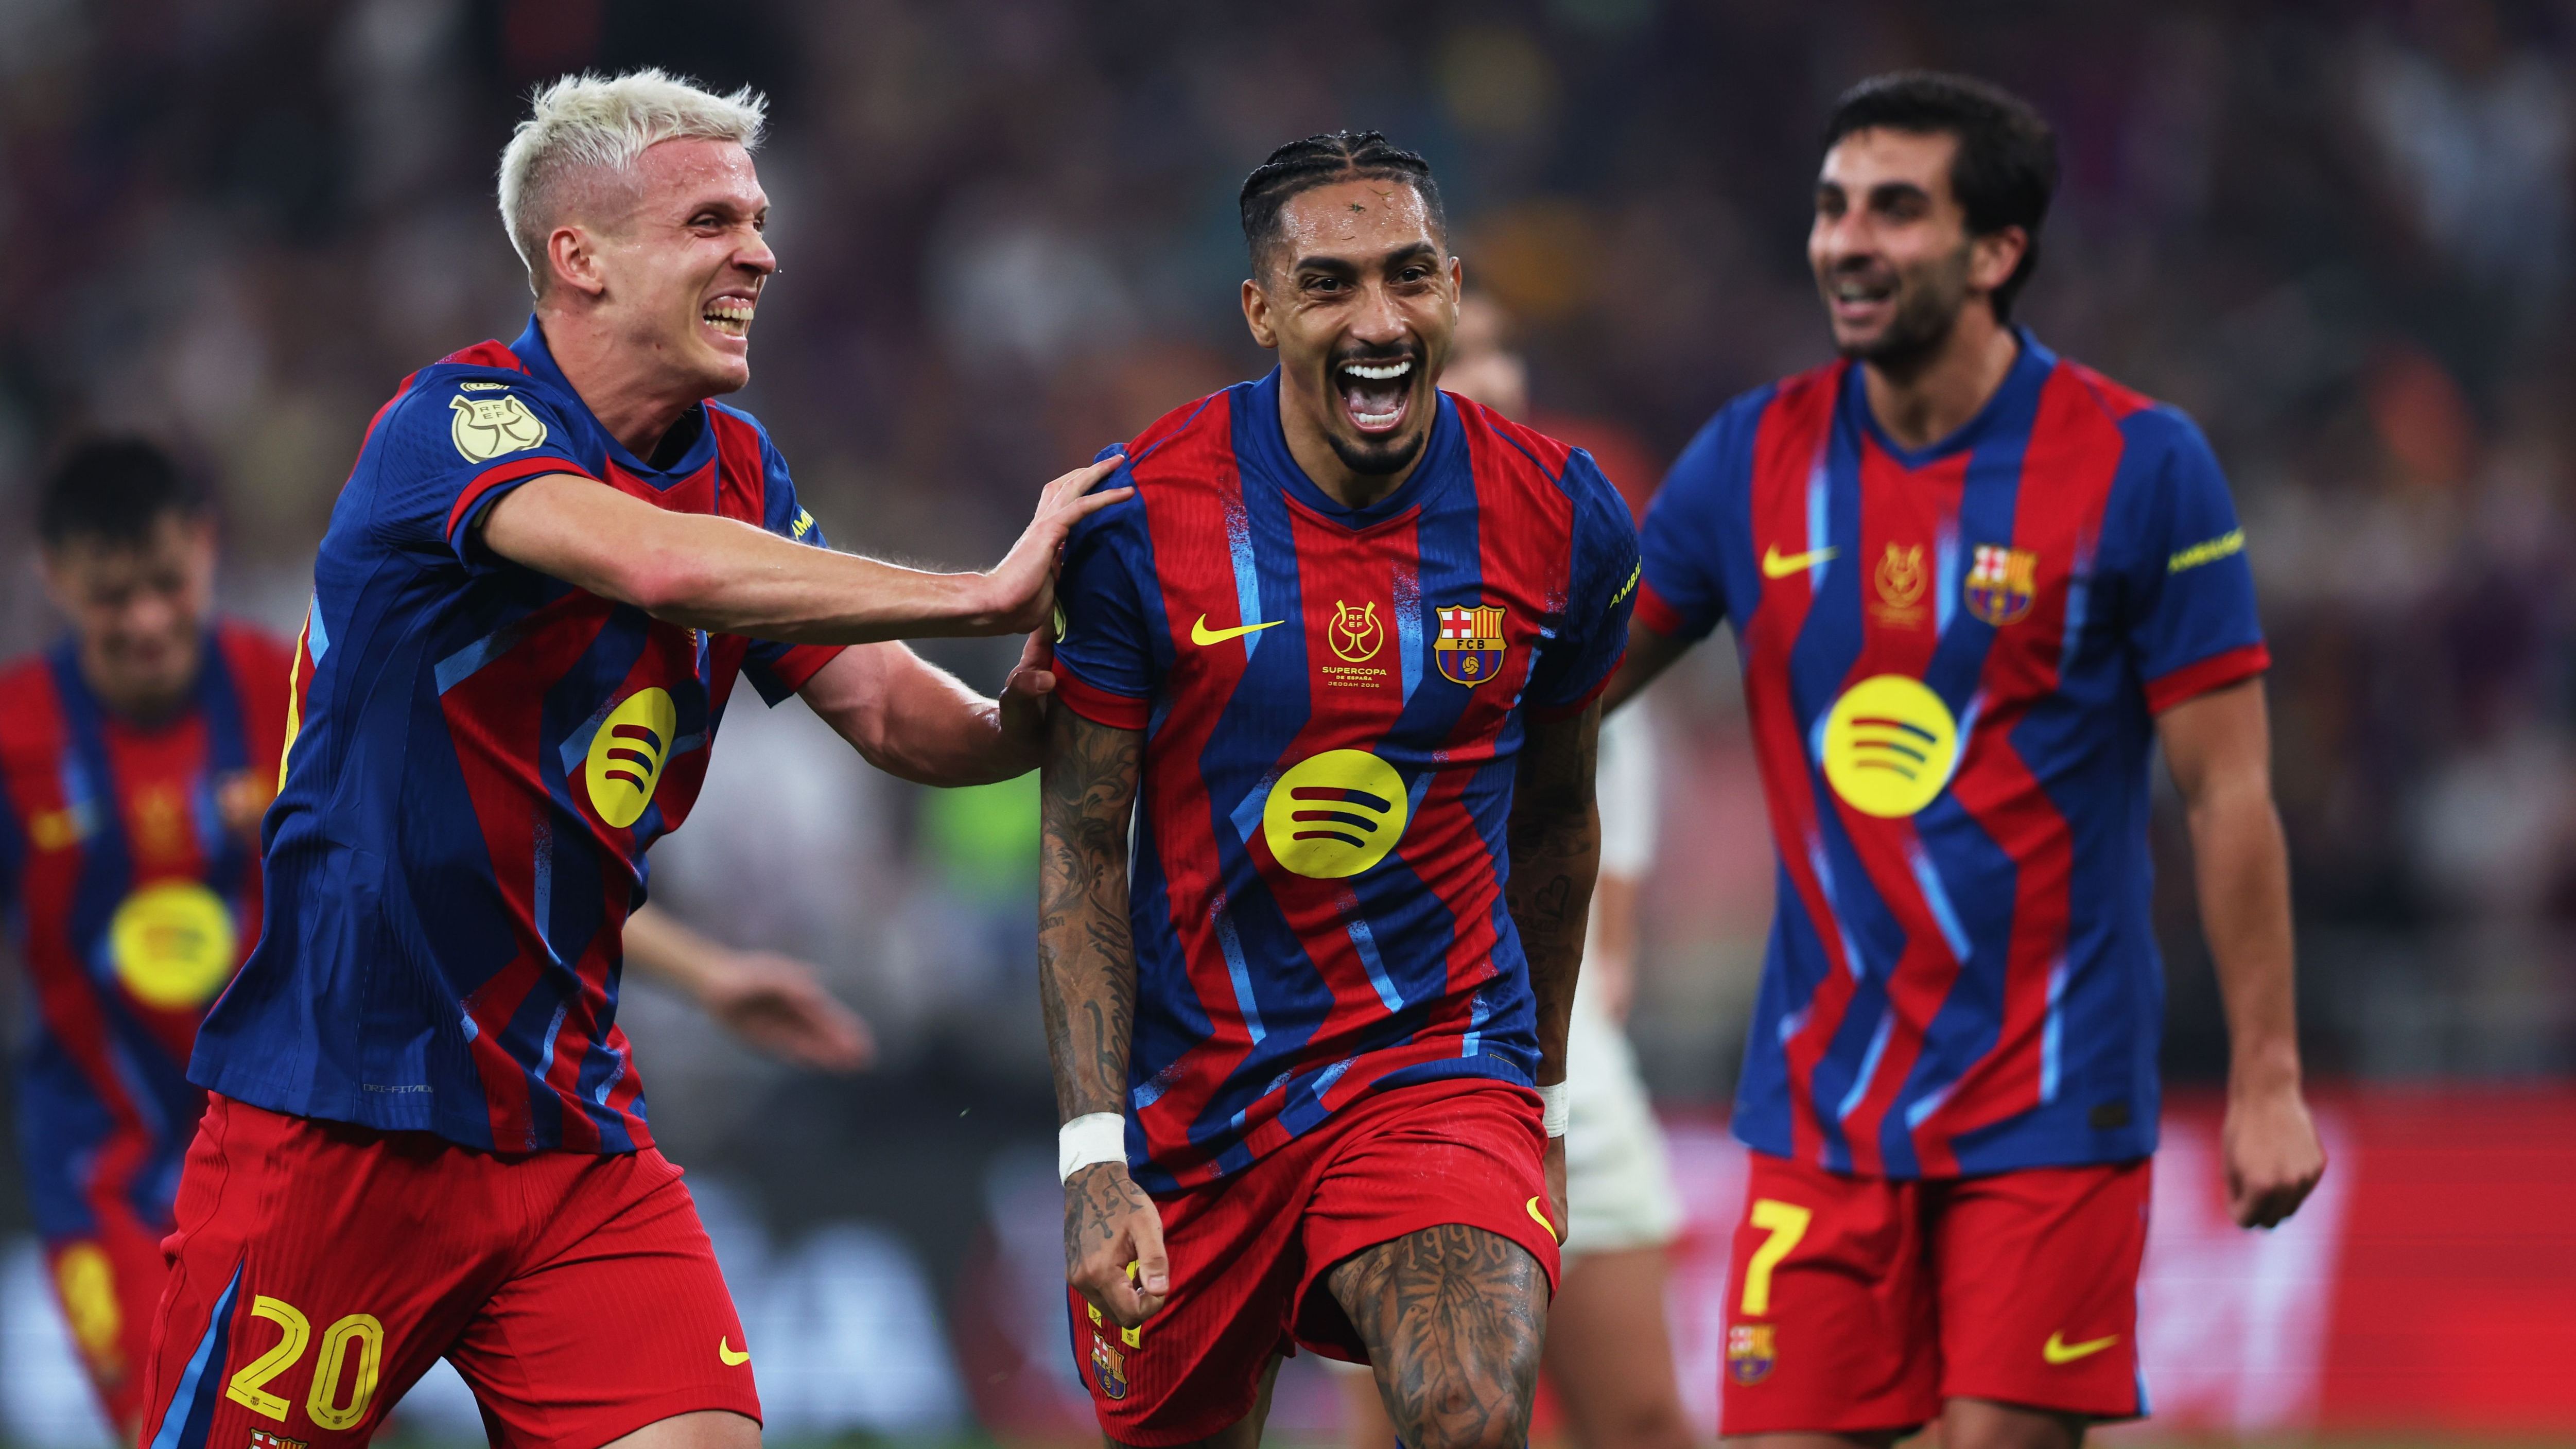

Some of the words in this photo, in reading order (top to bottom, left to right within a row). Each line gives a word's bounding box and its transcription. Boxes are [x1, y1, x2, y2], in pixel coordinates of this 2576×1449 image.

[1456, 639, 1485, 650] FCB
[1322, 667, 1387, 675] SUPERCOPA
[1740, 1197, 1814, 1317] 7
[225, 1294, 385, 1430] 20
[1101, 1359, 1114, 1376] FCB
